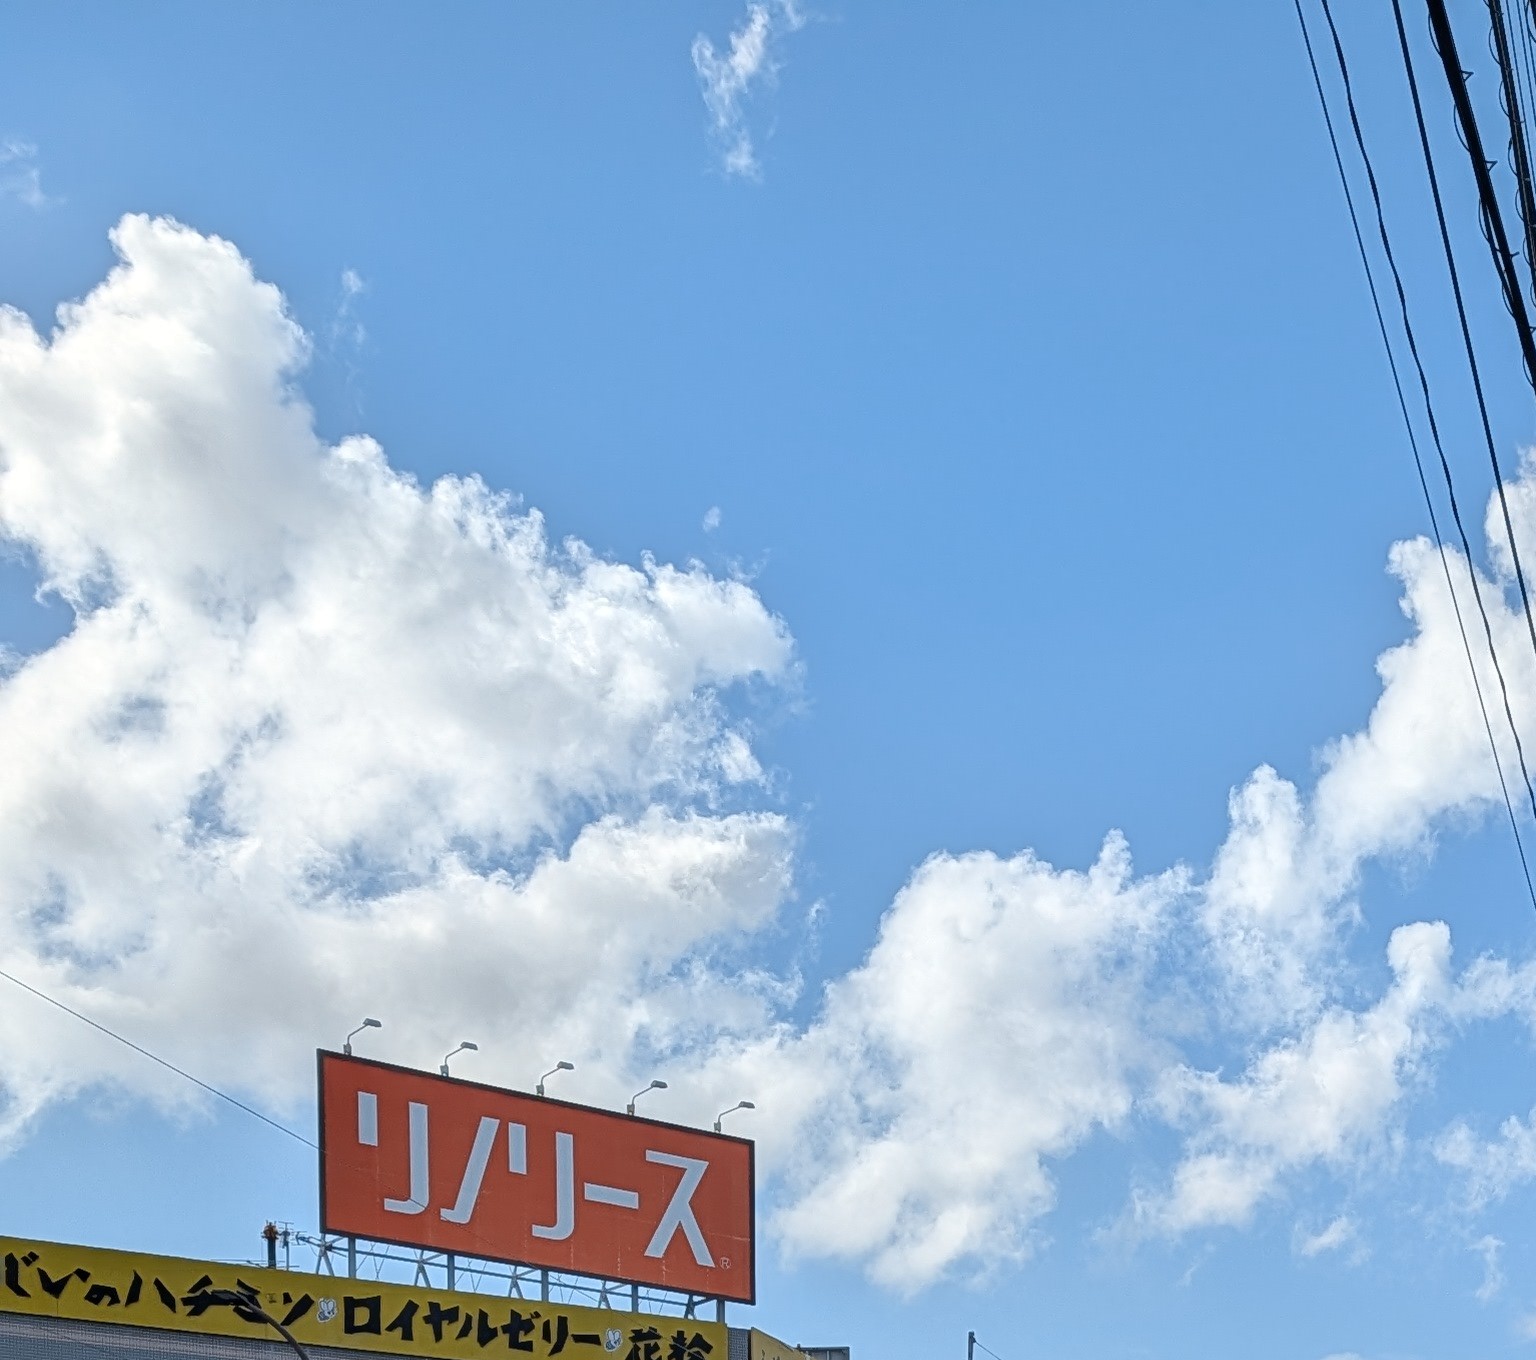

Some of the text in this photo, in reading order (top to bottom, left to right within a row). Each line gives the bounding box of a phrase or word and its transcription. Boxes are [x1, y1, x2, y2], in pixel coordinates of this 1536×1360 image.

[357, 1091, 715, 1268] リノリース
[344, 1295, 602, 1357] ロイヤルゼリー
